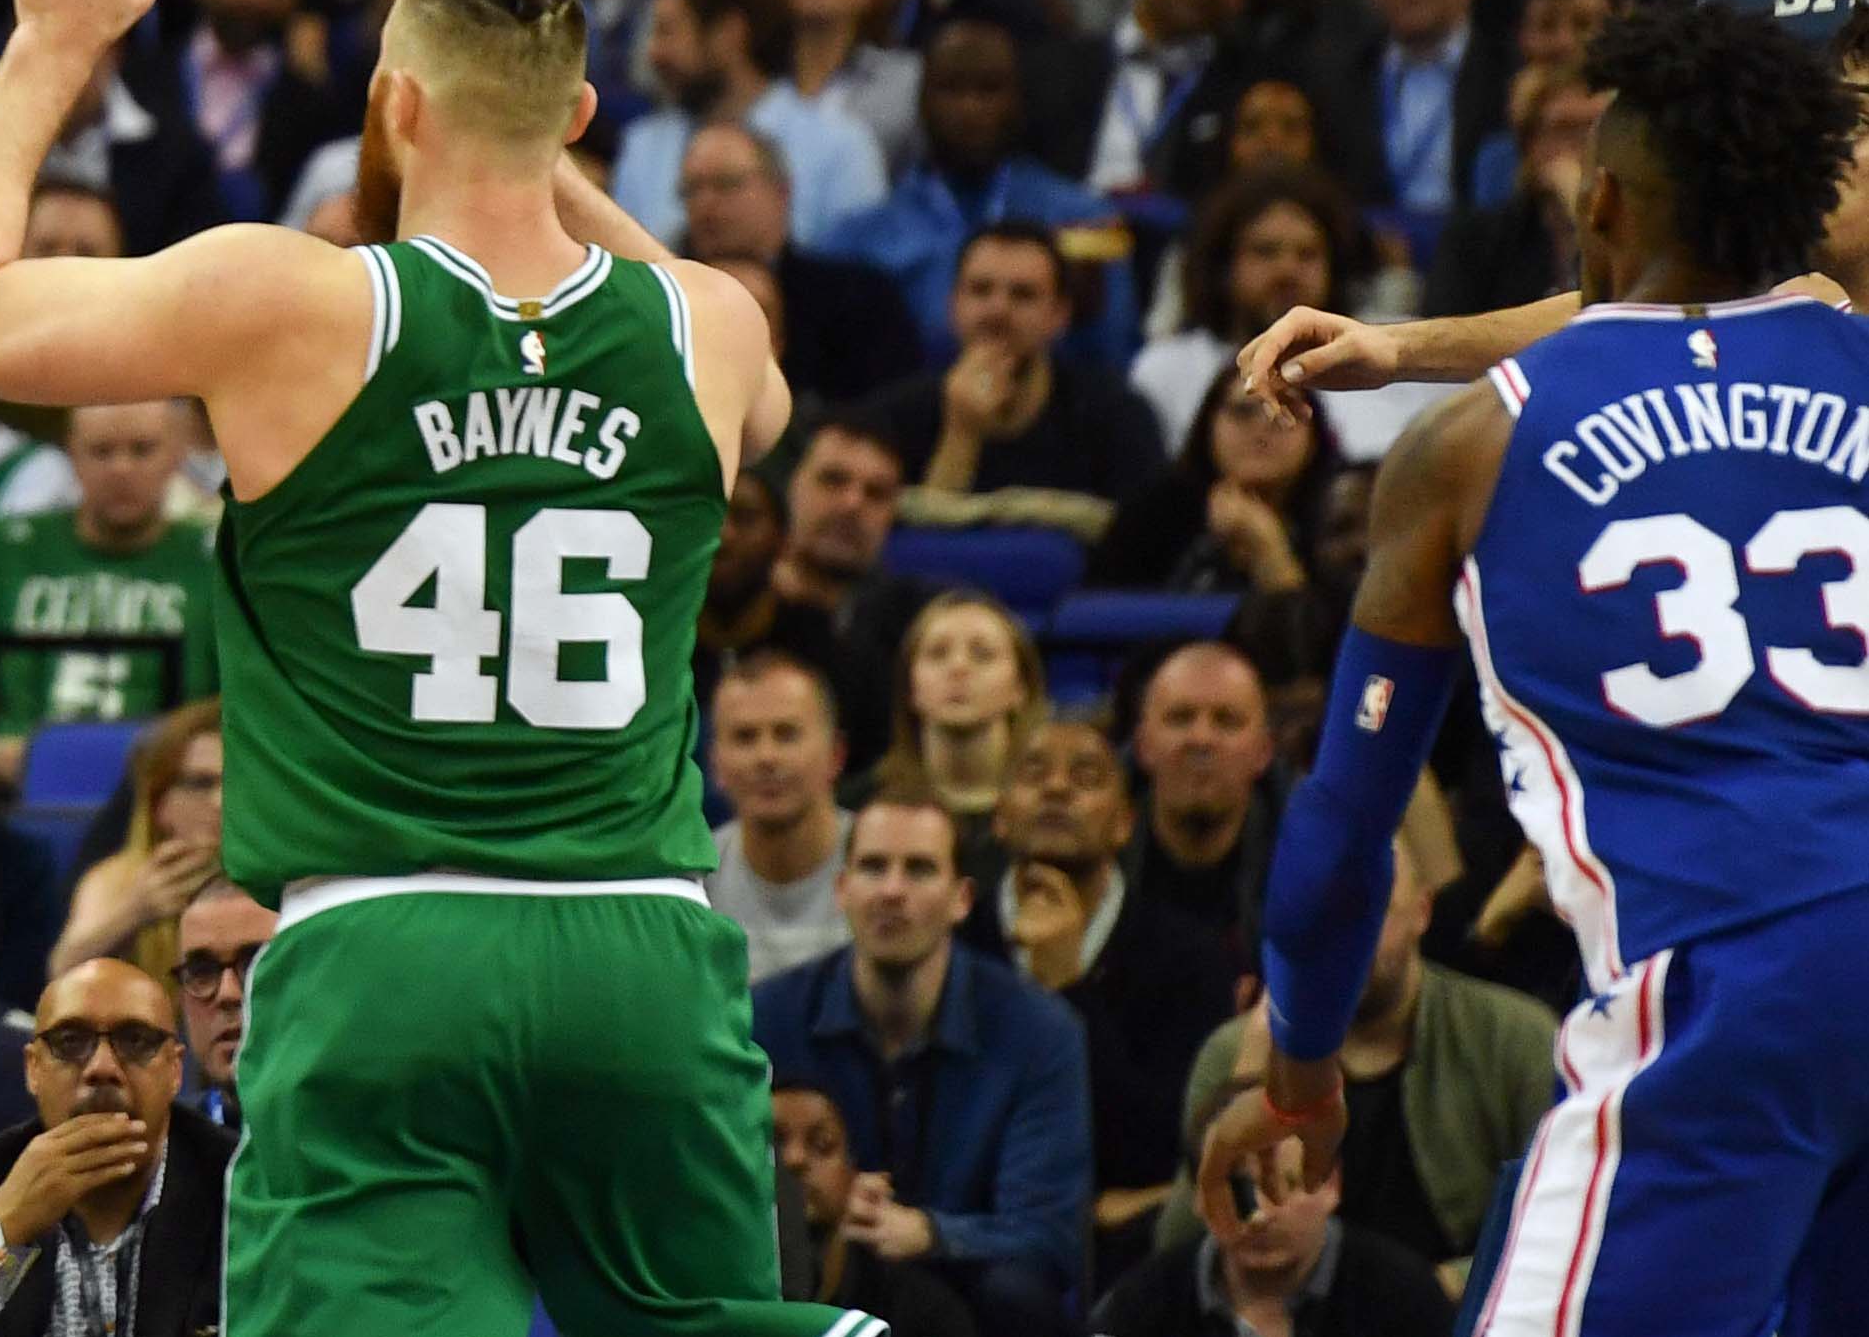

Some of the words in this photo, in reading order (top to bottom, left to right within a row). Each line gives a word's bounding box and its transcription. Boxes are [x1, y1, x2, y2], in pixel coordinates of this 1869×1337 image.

[412, 386, 642, 480] BAYNES
[1542, 382, 1869, 506] COVINGTON
[350, 502, 653, 731] 46
[1577, 505, 1869, 728] 33
